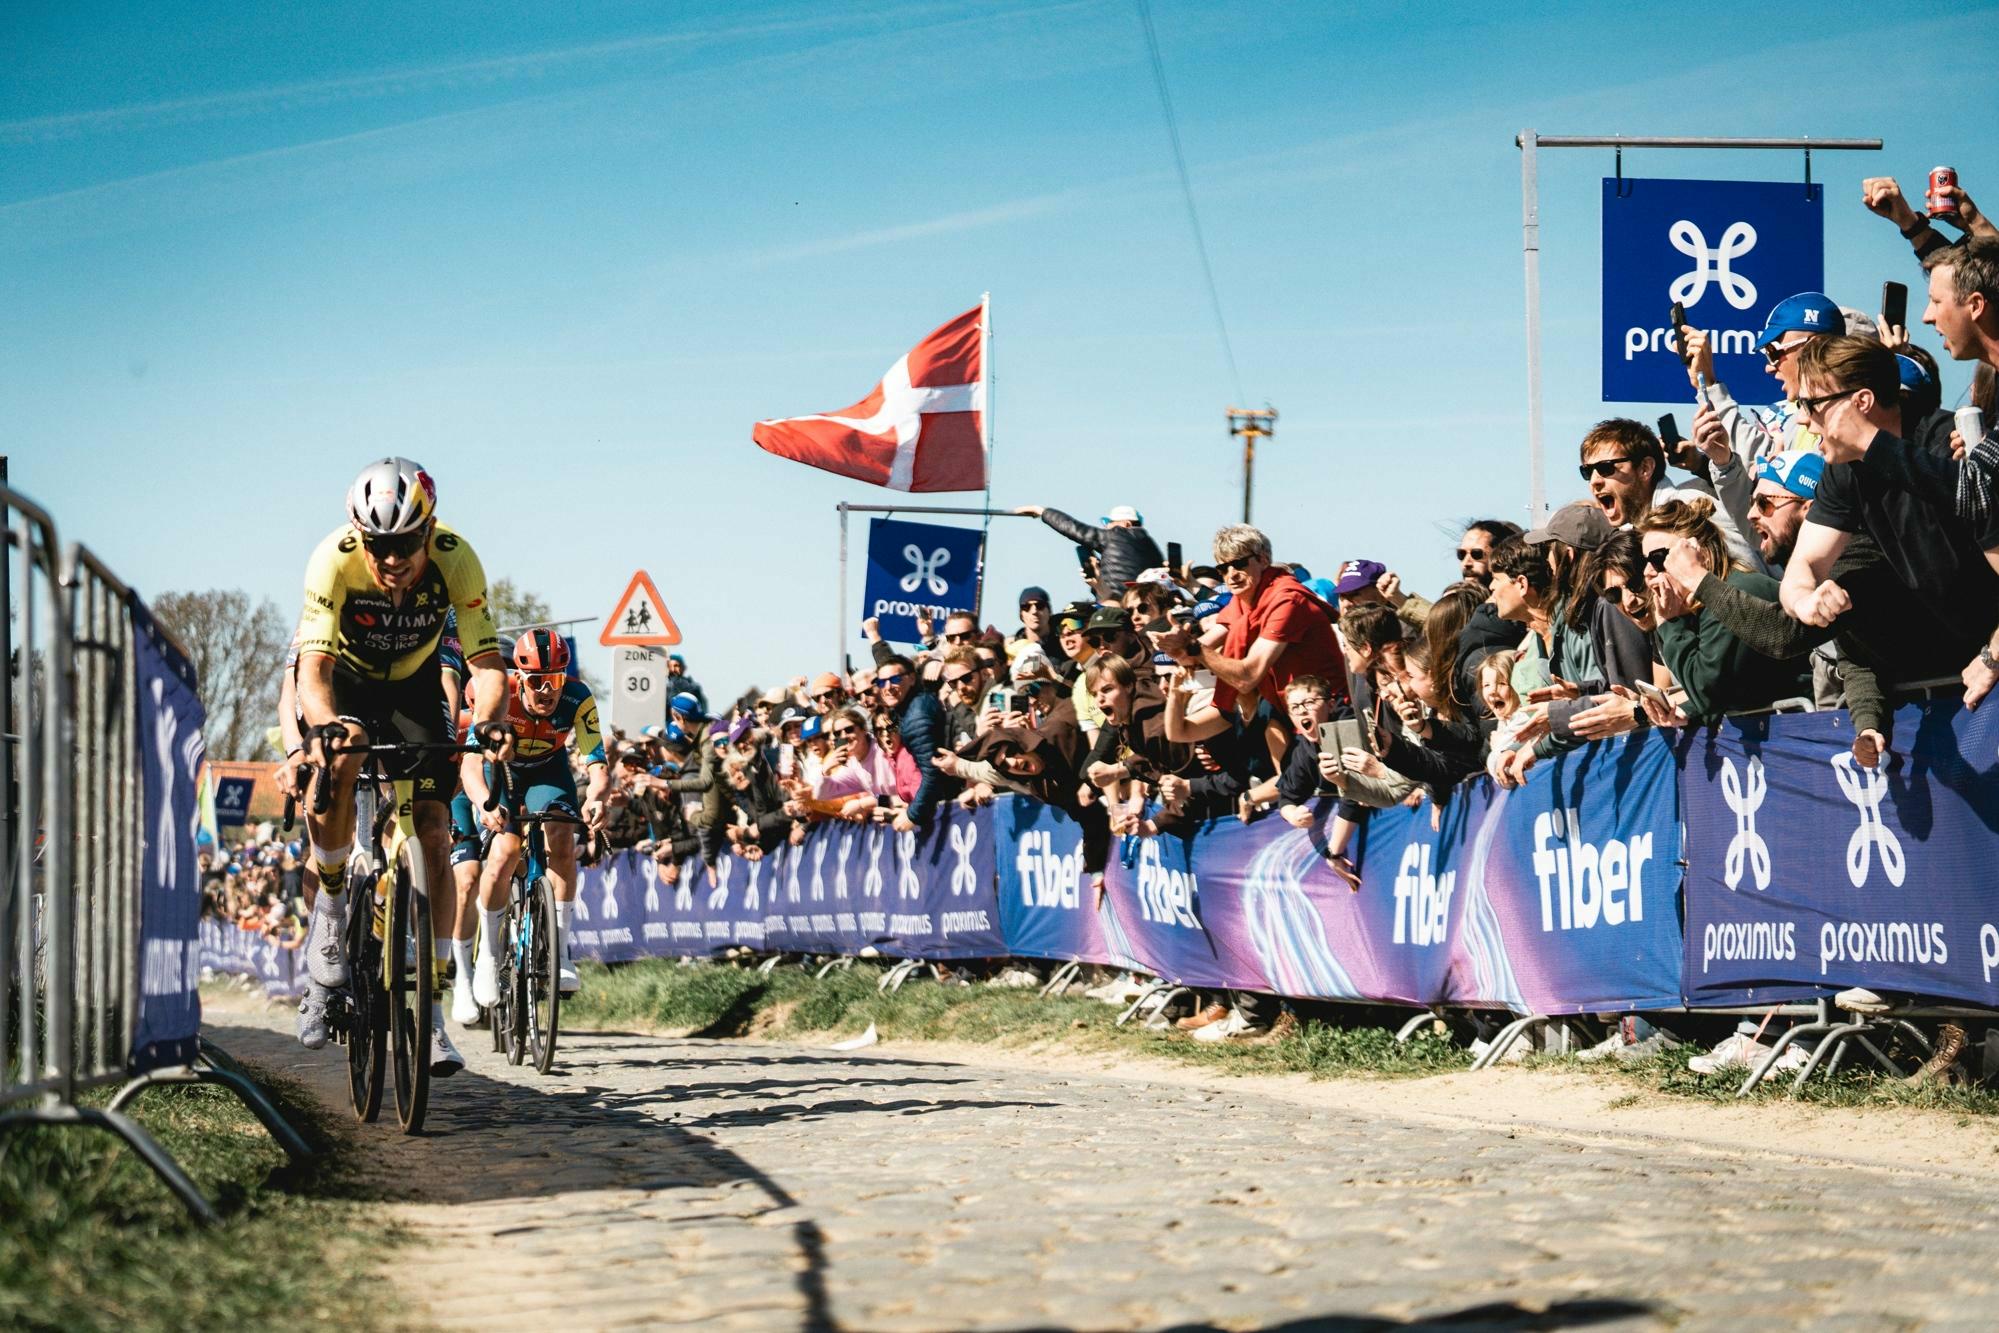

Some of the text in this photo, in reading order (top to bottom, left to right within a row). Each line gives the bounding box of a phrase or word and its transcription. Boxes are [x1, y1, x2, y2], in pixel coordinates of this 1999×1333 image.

[1625, 327, 1766, 360] prim
[381, 613, 436, 628] VISMA
[874, 599, 969, 620] proxmu
[624, 650, 655, 662] ZONE
[627, 676, 651, 692] 30
[1016, 829, 1084, 909] fiber
[1138, 837, 1203, 931] fiber
[1533, 807, 1653, 932] fiber
[1393, 841, 1456, 947] fiber
[942, 909, 990, 940] proximus
[1703, 922, 1796, 974] proximus
[1820, 922, 1948, 976] proximus
